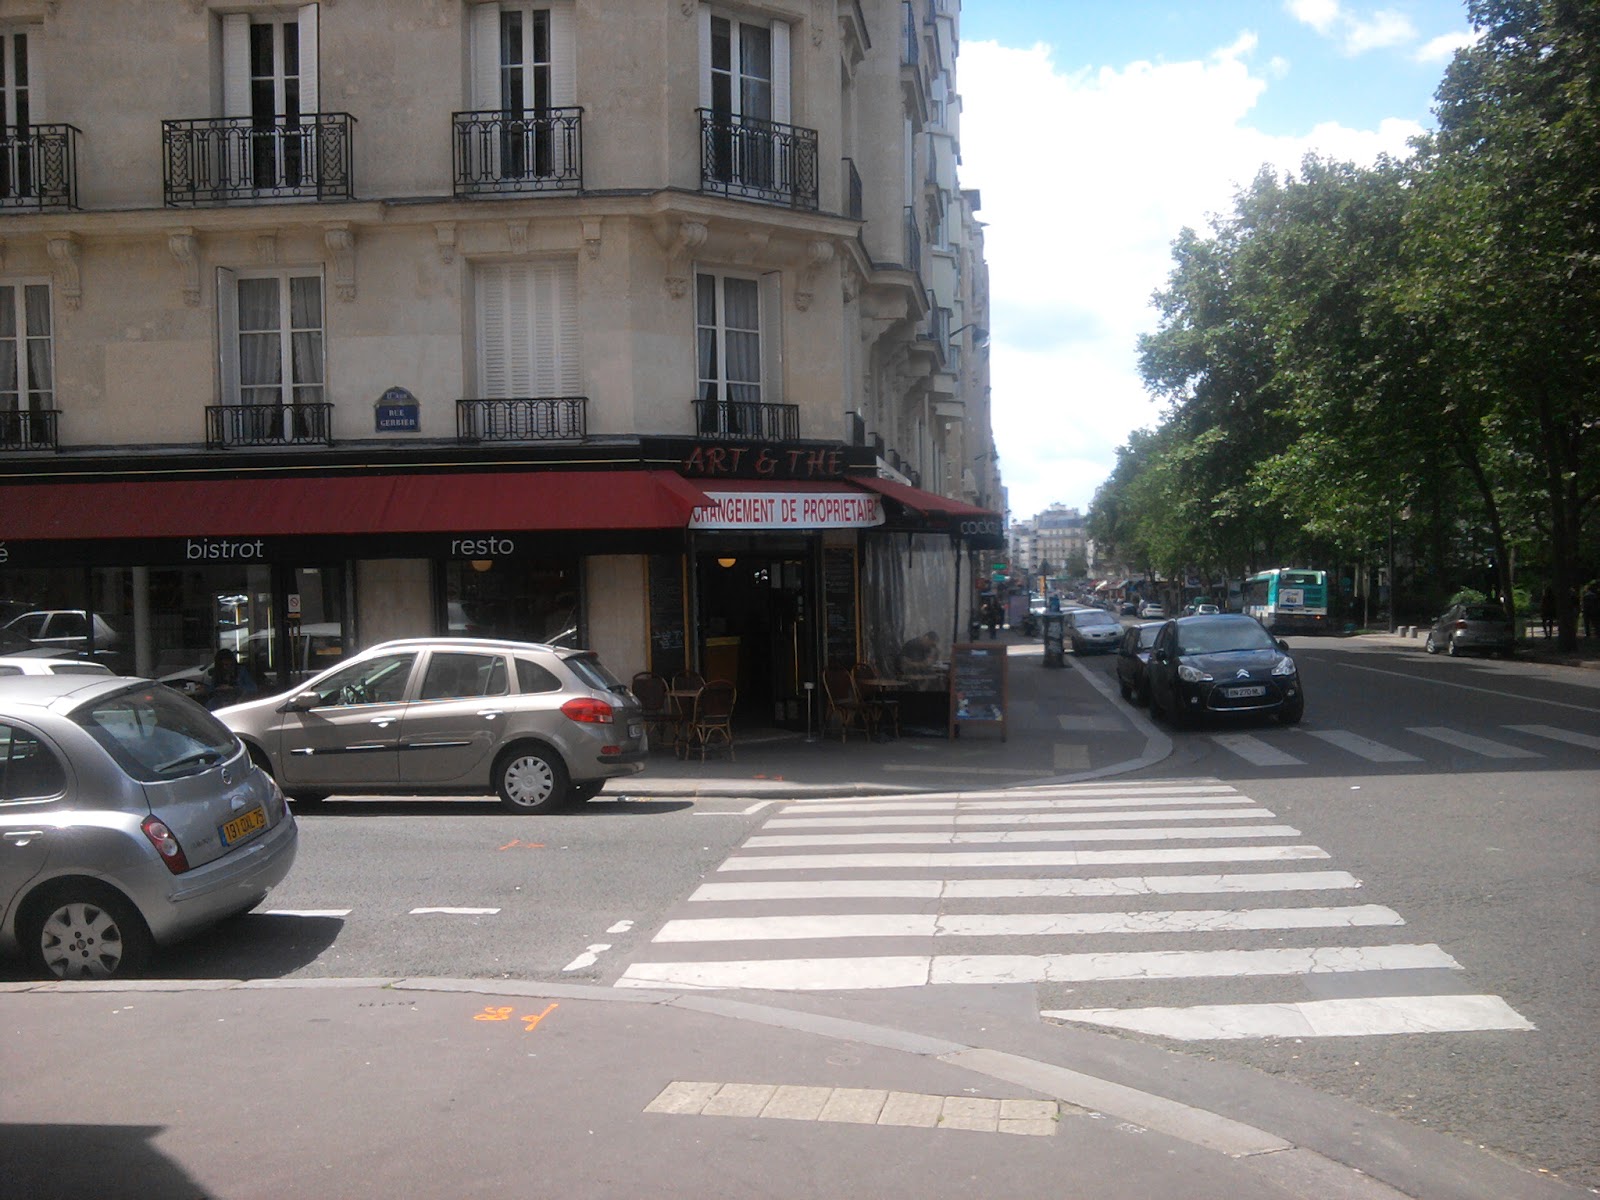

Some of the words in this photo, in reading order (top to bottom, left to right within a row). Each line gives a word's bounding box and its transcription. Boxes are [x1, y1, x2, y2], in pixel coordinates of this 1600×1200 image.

[684, 446, 749, 474] ART
[756, 448, 779, 475] &
[693, 498, 775, 523] CHANGEMENT
[781, 498, 798, 523] DE
[186, 538, 264, 560] bistrot
[451, 535, 515, 555] resto
[226, 822, 240, 840] 191
[254, 810, 265, 824] 75
